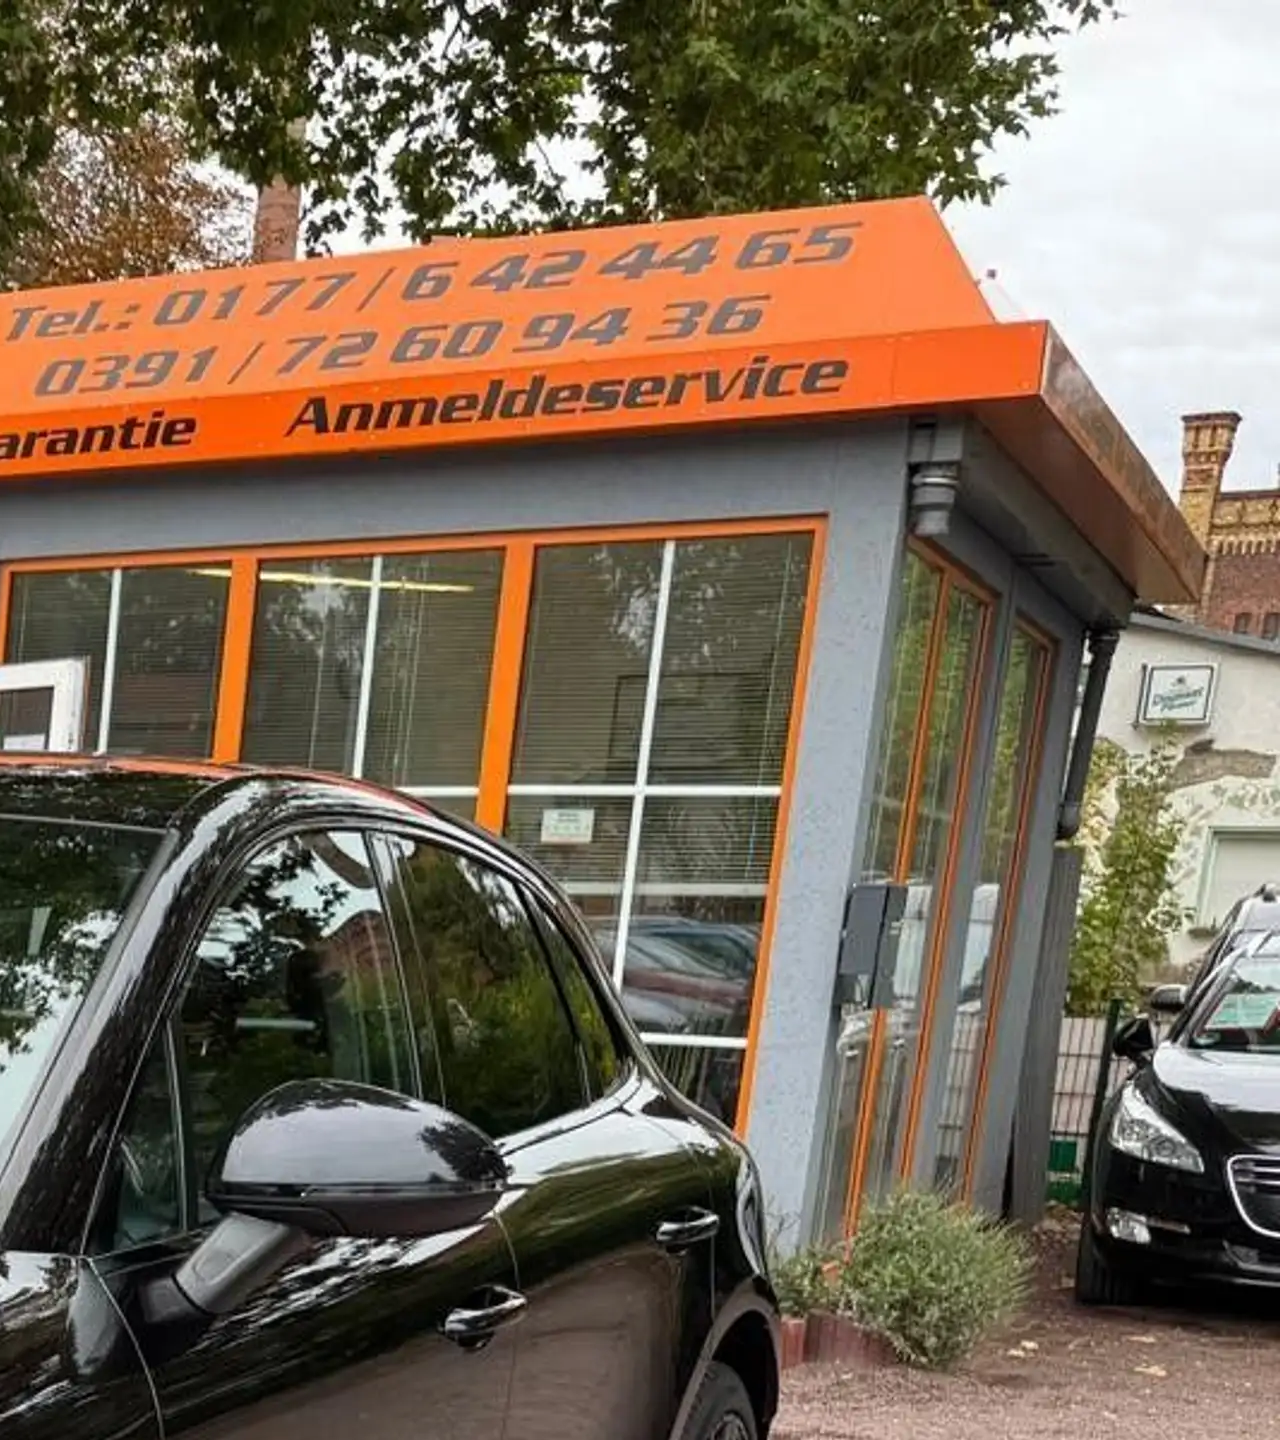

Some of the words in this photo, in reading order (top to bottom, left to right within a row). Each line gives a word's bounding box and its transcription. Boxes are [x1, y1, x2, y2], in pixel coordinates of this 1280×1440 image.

[6, 299, 140, 341] Tel.:
[470, 249, 586, 292] 42
[598, 234, 720, 280] 44
[734, 221, 864, 269] 65
[33, 345, 218, 397] 0391
[276, 331, 378, 375] 72
[390, 320, 504, 364] 60
[513, 306, 632, 352] 94
[645, 293, 771, 342] 36
[284, 355, 851, 436] Anmeldeservice
